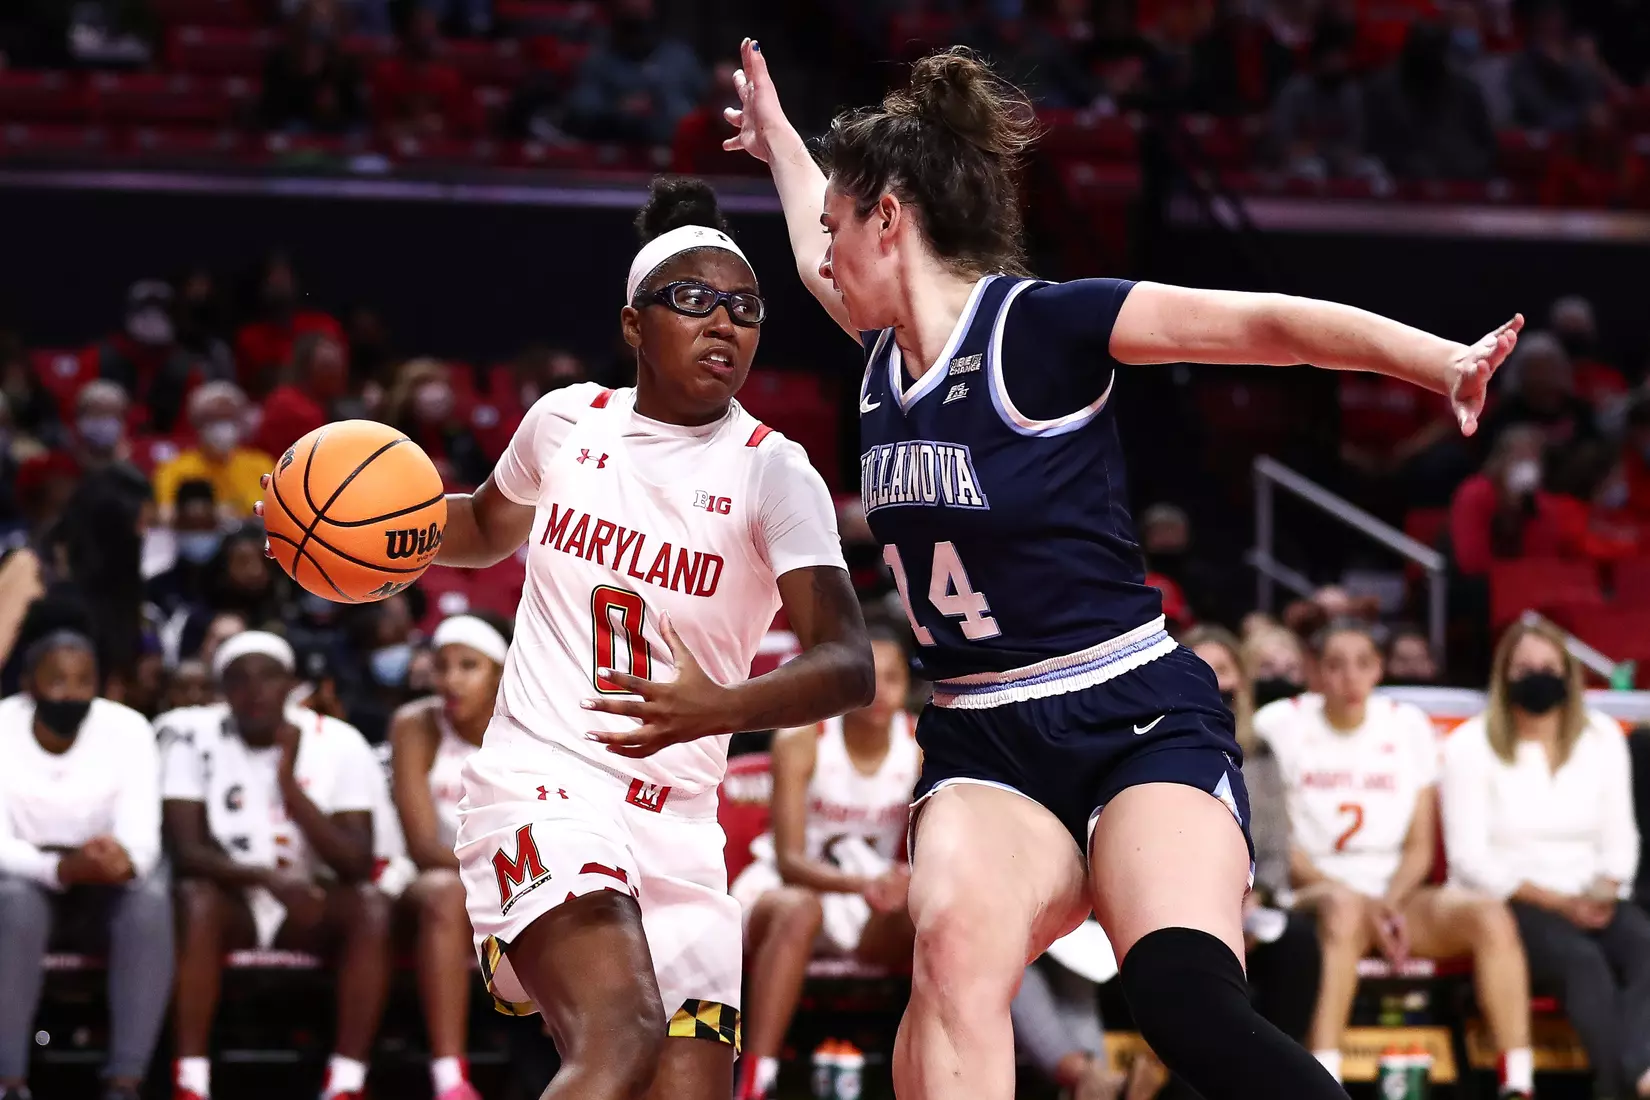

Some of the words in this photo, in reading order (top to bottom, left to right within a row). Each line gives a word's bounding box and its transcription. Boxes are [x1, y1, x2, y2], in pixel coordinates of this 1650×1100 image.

[540, 503, 724, 598] MARYLAND
[882, 540, 1003, 647] 14
[591, 584, 652, 695] 0
[1334, 802, 1366, 854] 2
